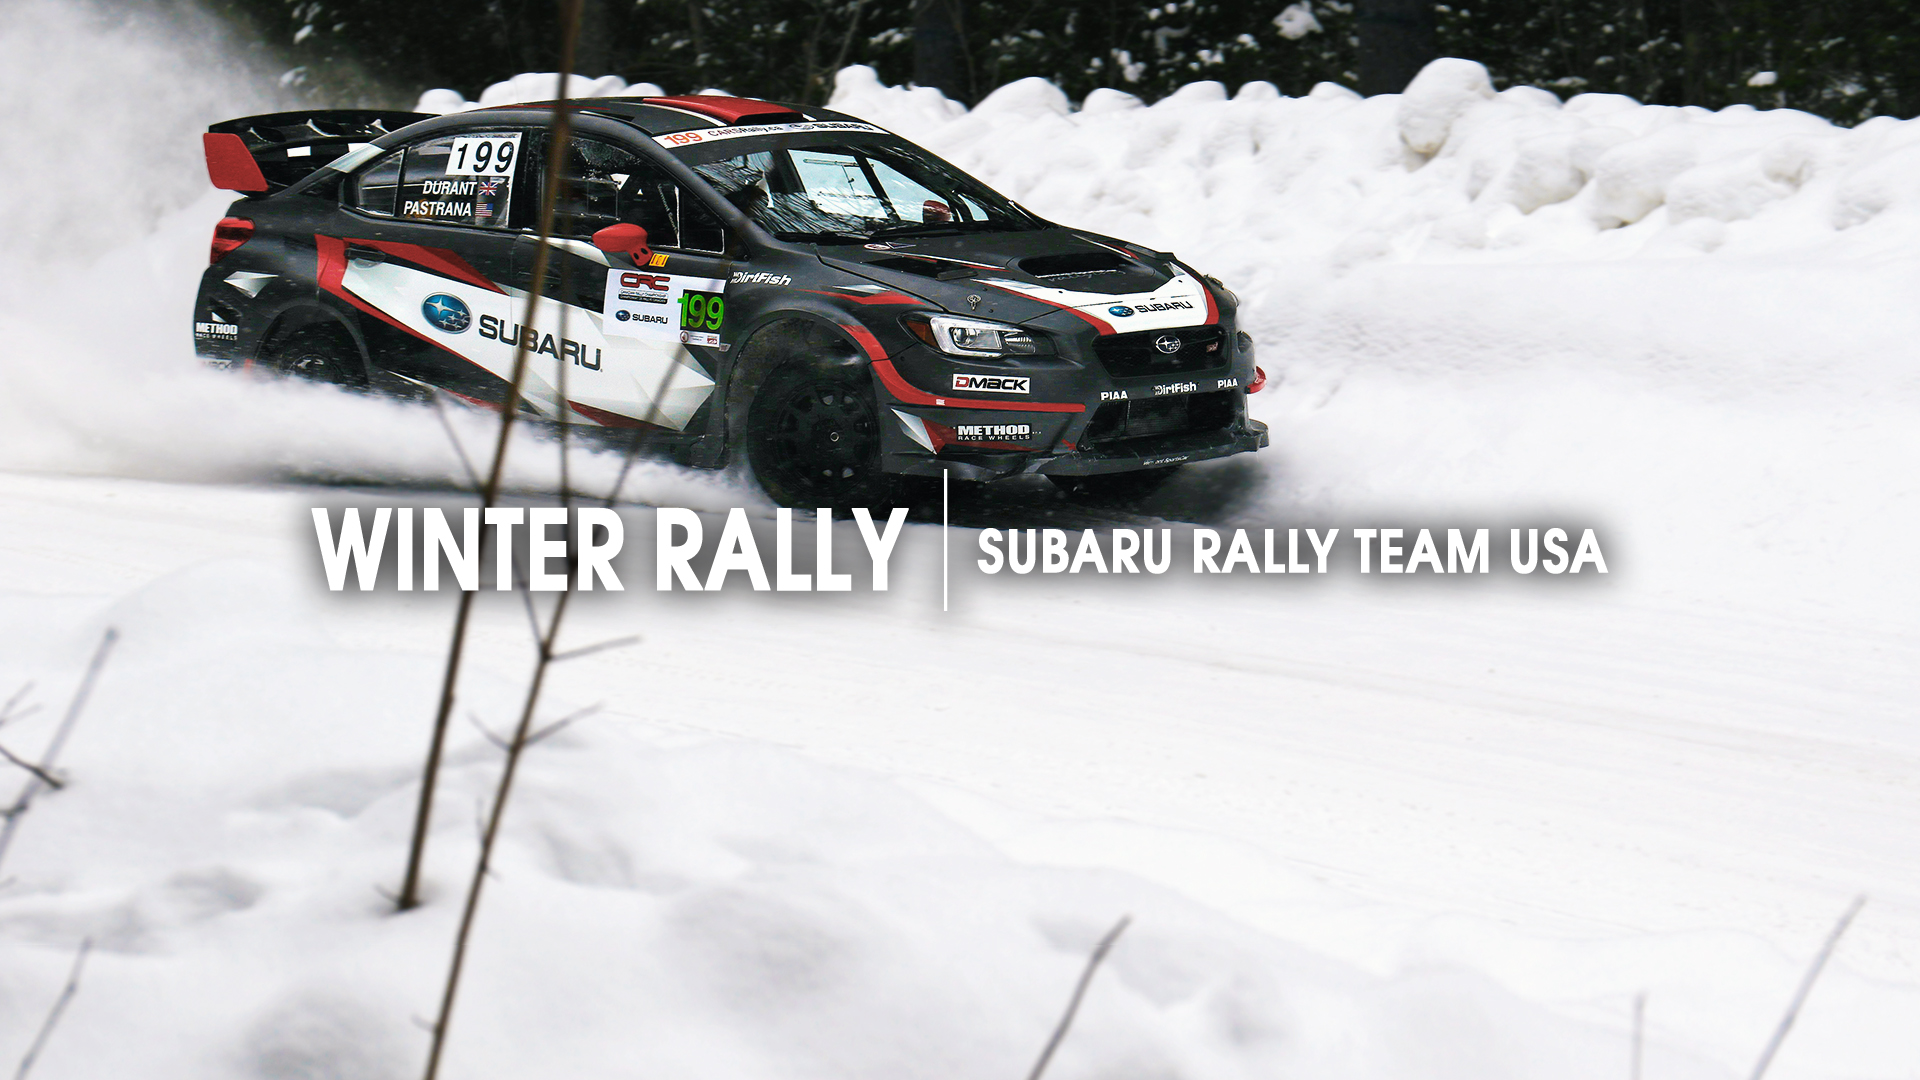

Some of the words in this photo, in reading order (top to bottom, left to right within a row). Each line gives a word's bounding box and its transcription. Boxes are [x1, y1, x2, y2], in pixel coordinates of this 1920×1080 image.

[664, 132, 703, 147] 199
[457, 141, 515, 173] 199
[422, 181, 478, 196] DURANT
[403, 200, 472, 217] PASTRANA
[620, 272, 671, 291] CRC
[731, 271, 792, 286] DirtFish
[677, 292, 725, 331] 199
[1134, 301, 1194, 313] SUBARU
[632, 313, 669, 325] SUBARU
[195, 322, 239, 335] METHOD
[478, 313, 602, 371] SUBARU
[1153, 381, 1198, 396] DirtFish
[1217, 378, 1239, 389] PIAA
[1100, 390, 1129, 401] PIAA
[957, 424, 1031, 436] METHOD
